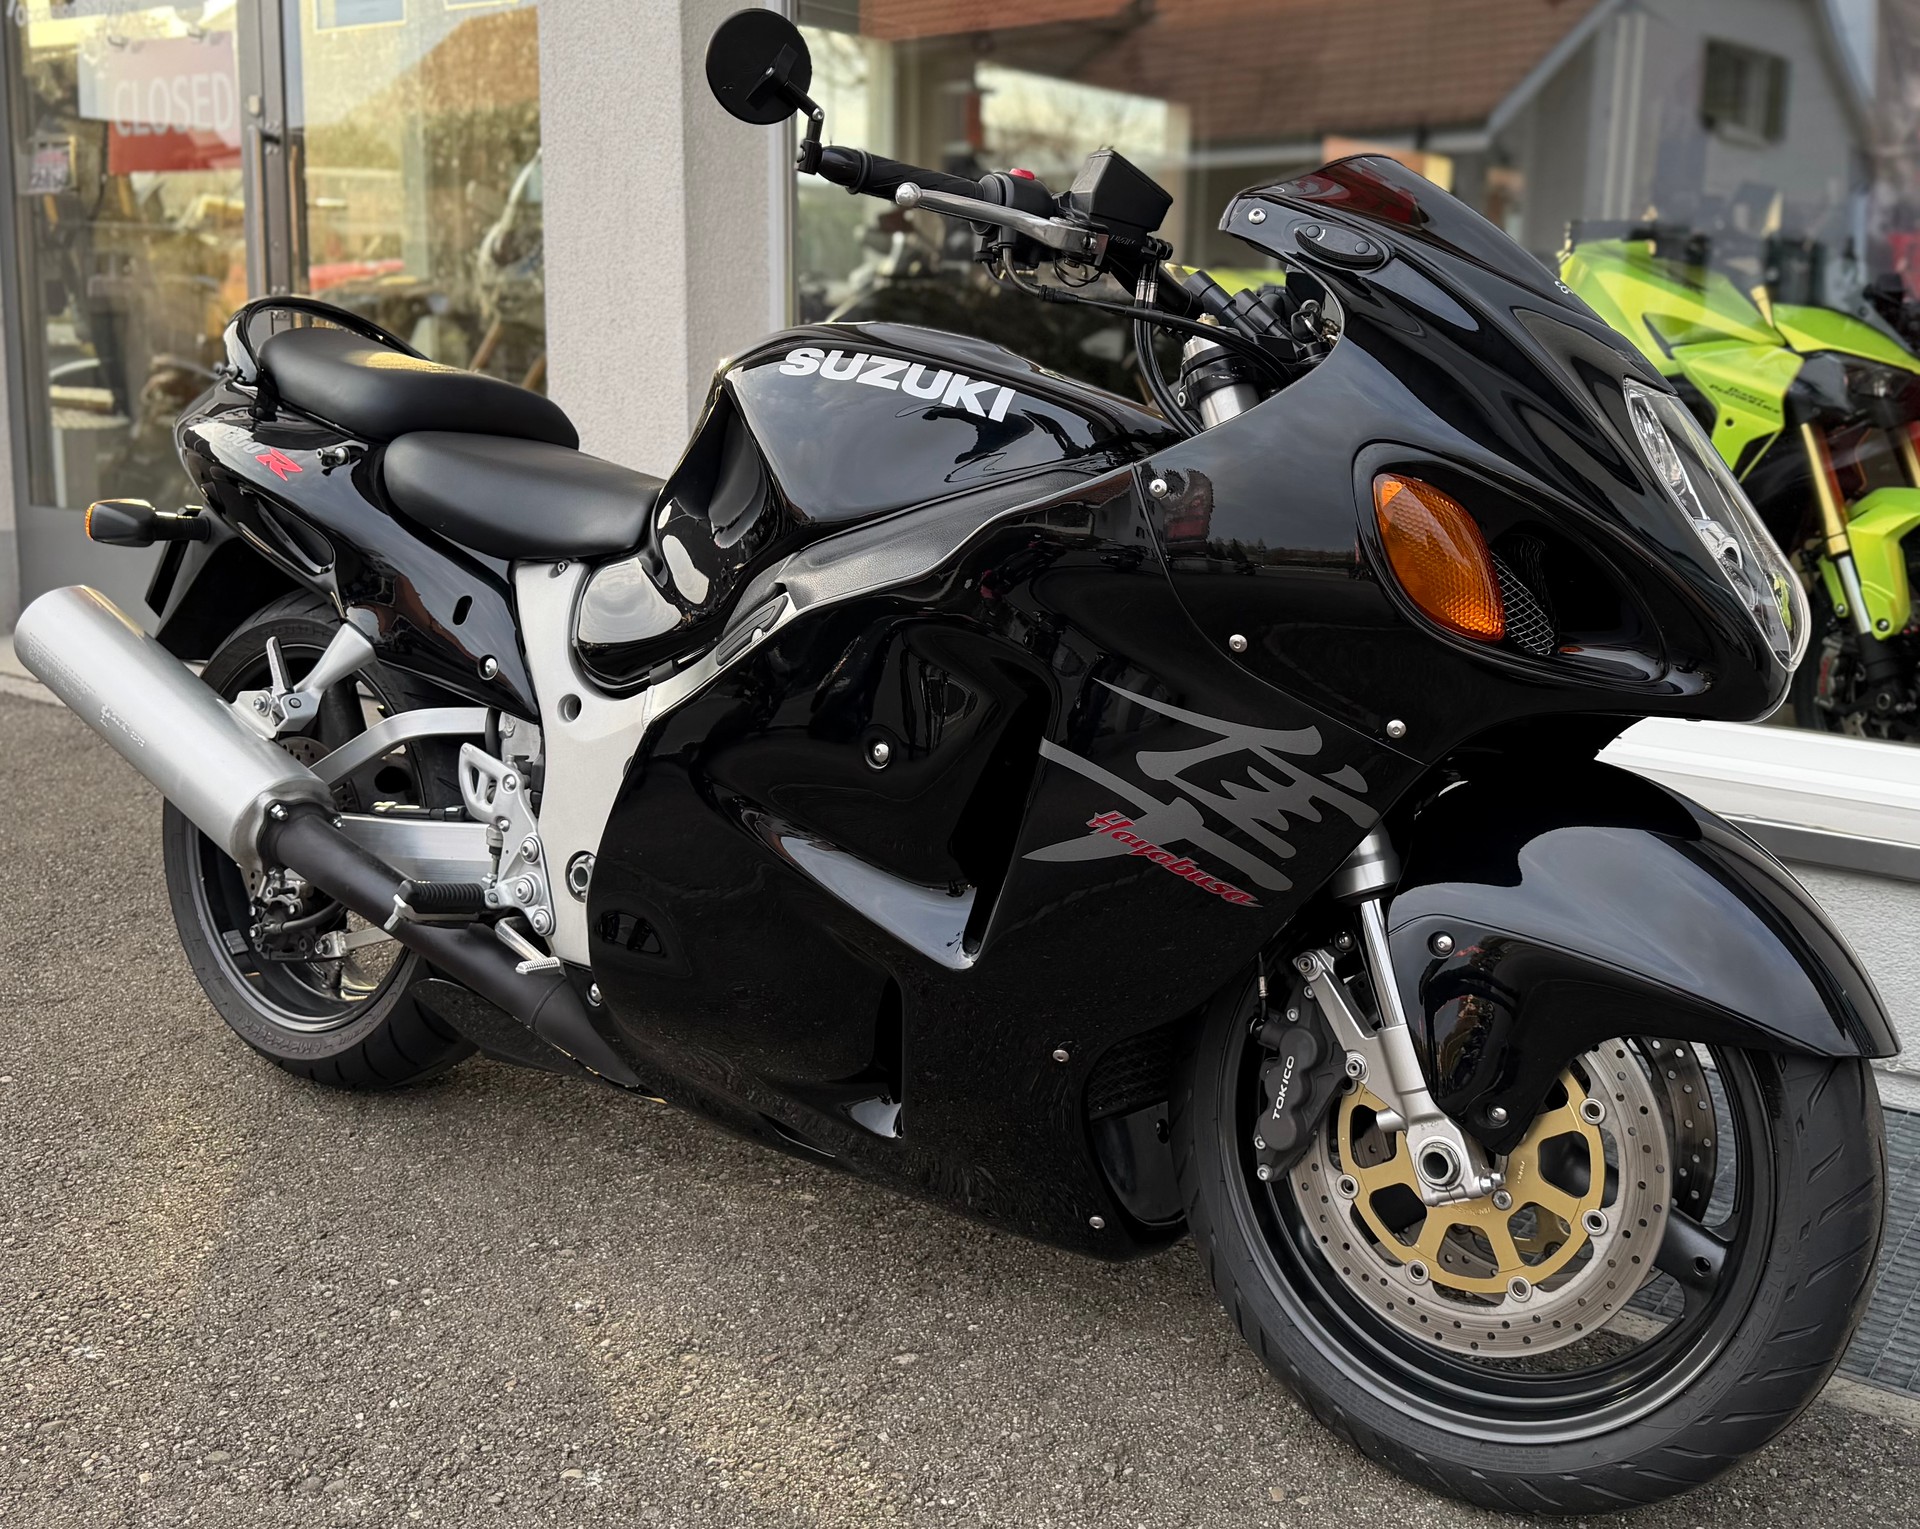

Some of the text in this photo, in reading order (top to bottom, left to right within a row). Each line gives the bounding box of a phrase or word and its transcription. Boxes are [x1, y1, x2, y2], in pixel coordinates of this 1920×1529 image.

[115, 72, 234, 138] CLOSED
[778, 347, 1016, 423] SUZUKI
[1086, 809, 1264, 908] Hayabusa
[1272, 1055, 1295, 1120] TOKICO
